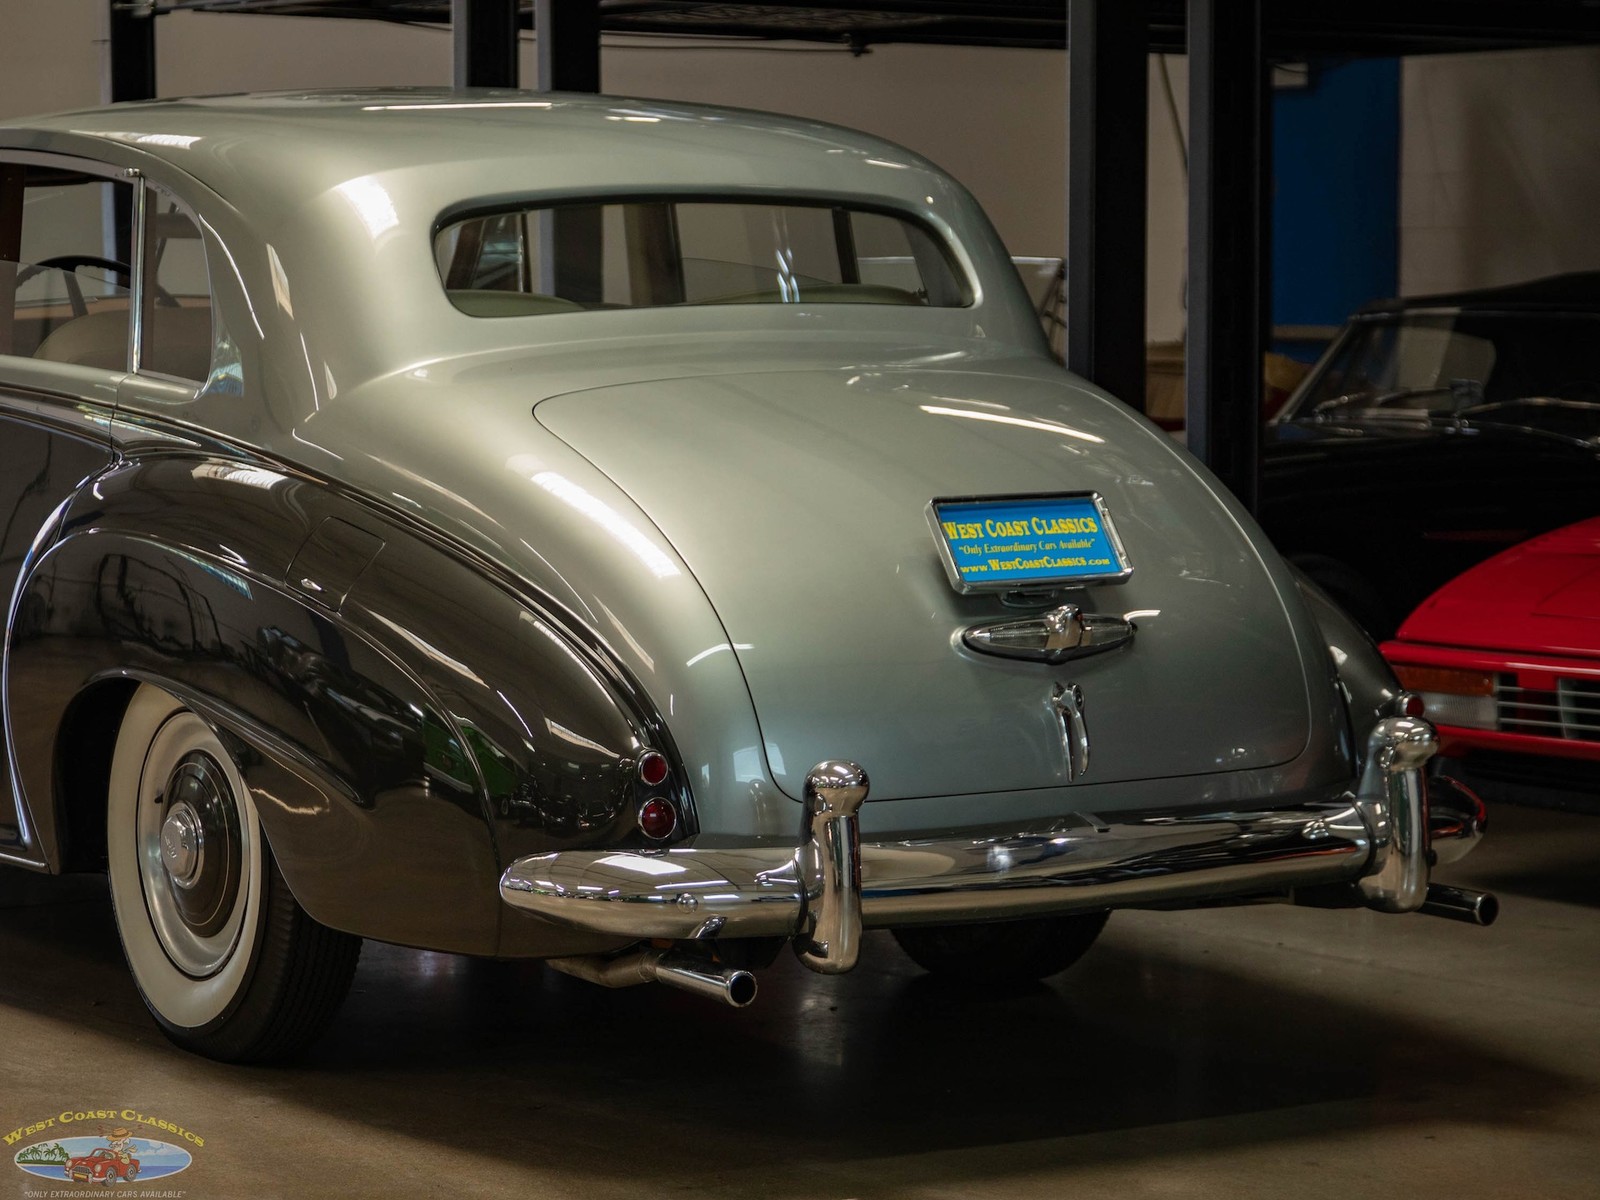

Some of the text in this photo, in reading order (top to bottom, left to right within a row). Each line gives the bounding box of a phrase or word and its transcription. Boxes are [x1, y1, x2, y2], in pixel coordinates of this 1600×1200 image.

[943, 516, 1098, 540] WEST COAST CLASSICS
[984, 542, 1037, 554] Extraordinary
[1038, 541, 1057, 550] Cars
